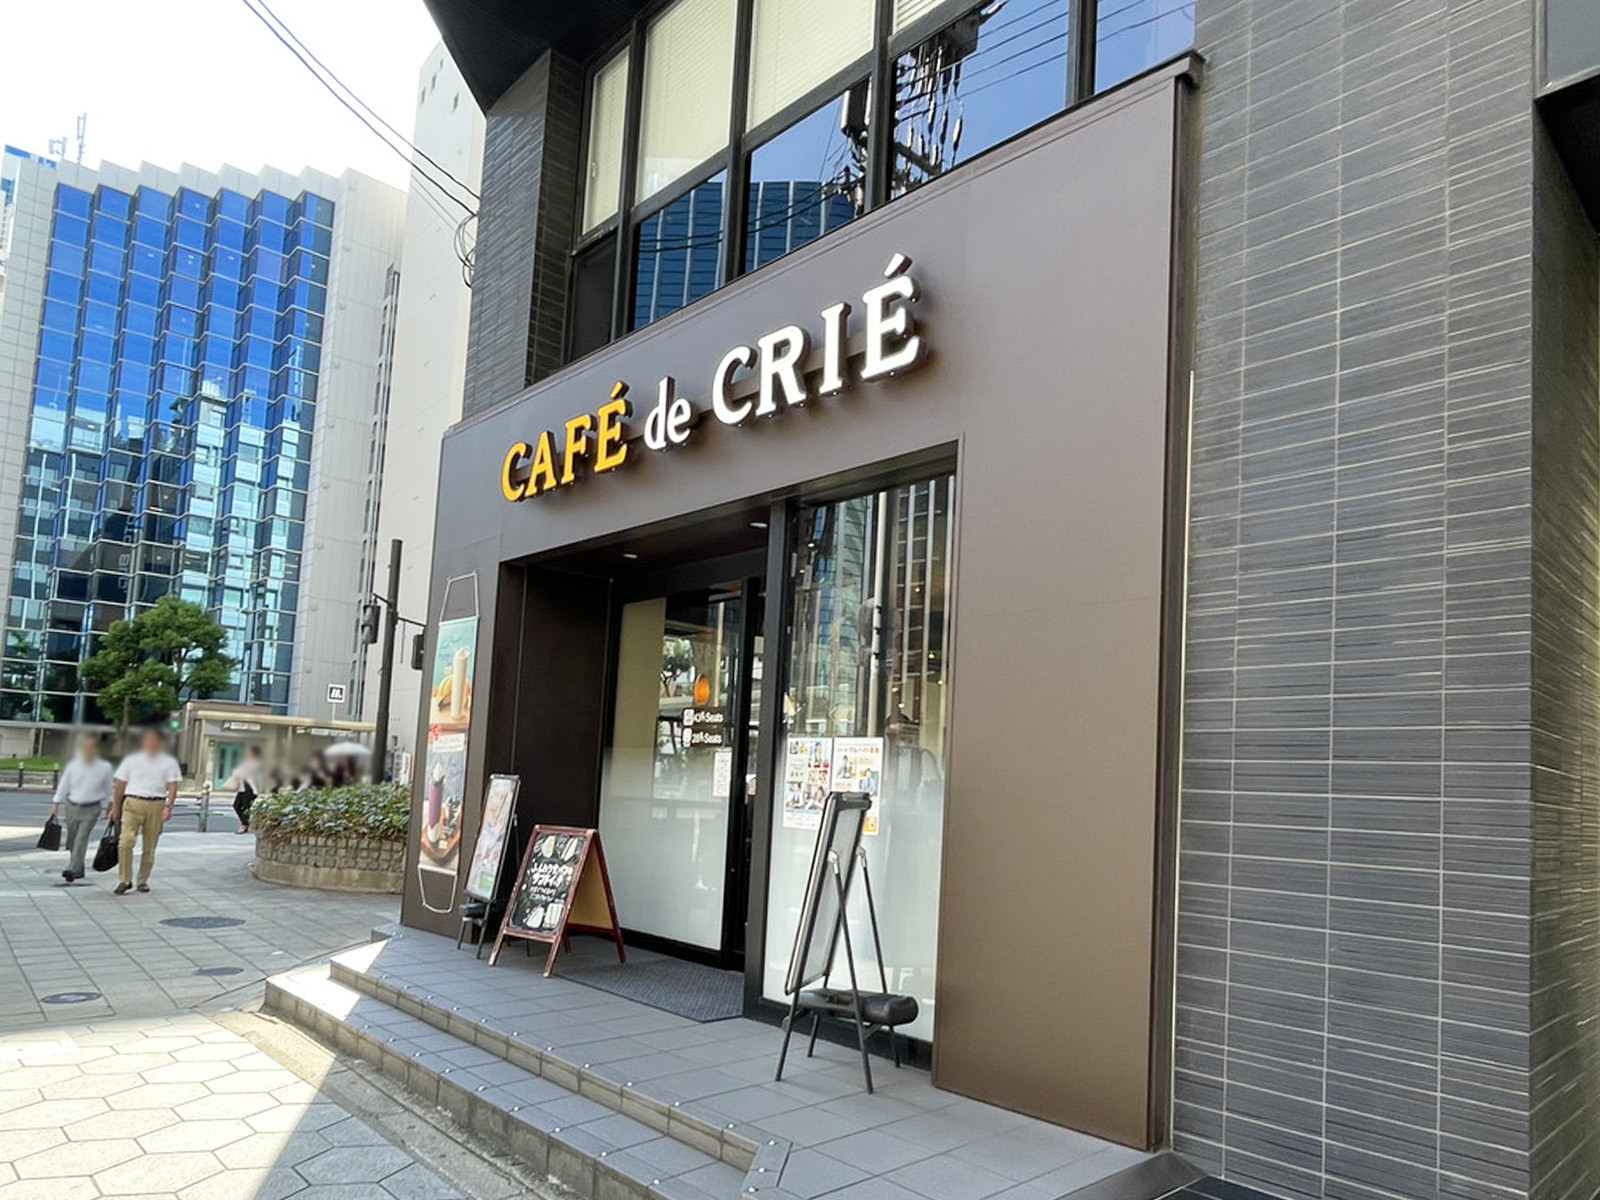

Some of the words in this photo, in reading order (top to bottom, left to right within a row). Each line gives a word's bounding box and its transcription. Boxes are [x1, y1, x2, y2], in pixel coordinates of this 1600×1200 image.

[501, 381, 629, 502] CAFÉ
[643, 376, 693, 451] de
[711, 252, 923, 426] CRIÉ
